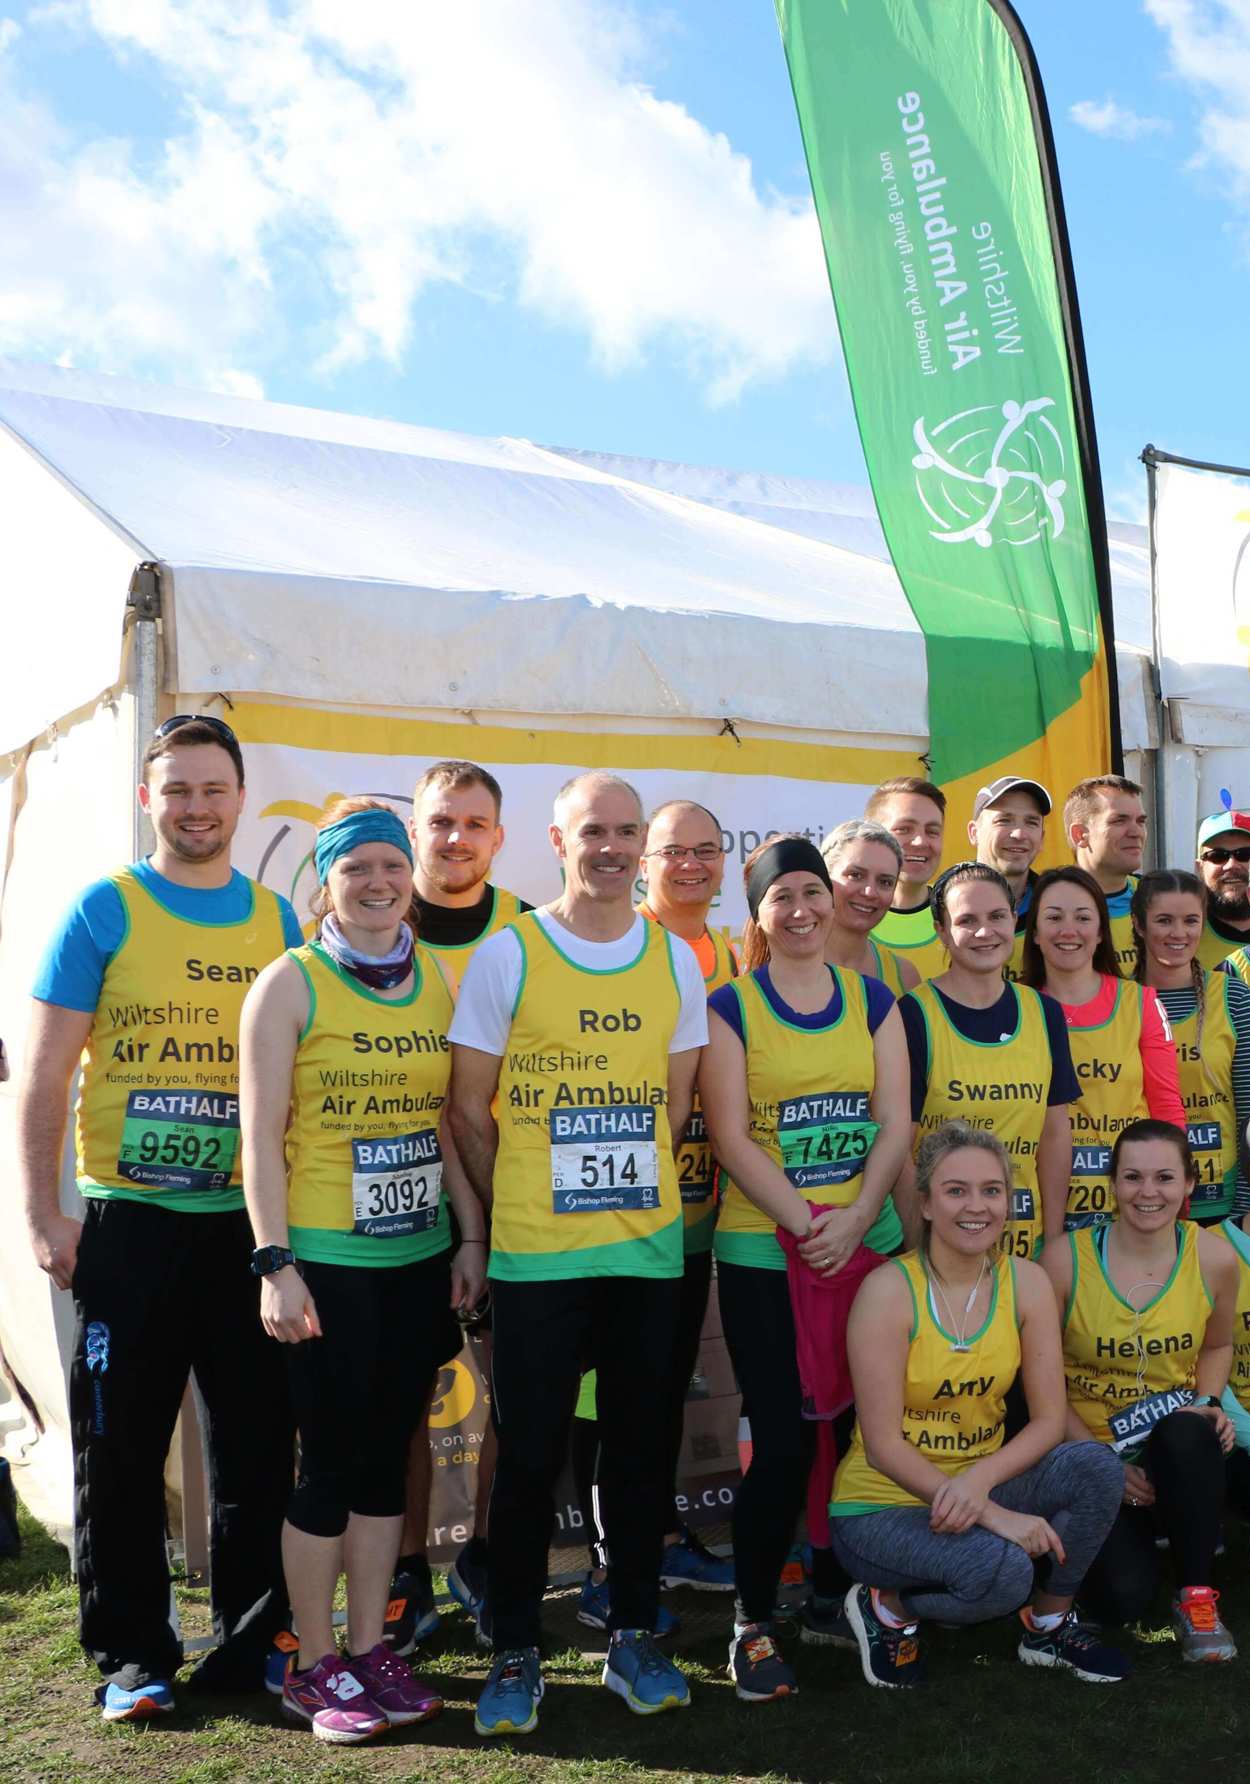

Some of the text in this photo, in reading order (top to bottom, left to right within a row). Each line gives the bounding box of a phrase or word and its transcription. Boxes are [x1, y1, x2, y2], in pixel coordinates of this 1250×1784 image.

[186, 959, 261, 983] Sean
[109, 1001, 220, 1028] Wiltshire
[579, 1008, 642, 1033] Rob
[112, 1037, 241, 1063] Air Amb
[353, 1029, 449, 1058] Sophie
[509, 1051, 608, 1072] Wiltshire
[106, 1072, 143, 1084] funded
[147, 1073, 161, 1086] by
[195, 1072, 227, 1086] flying
[319, 1070, 408, 1087] Wiltshire
[509, 1081, 668, 1108] Air Ambula
[948, 1079, 1043, 1103] Swanny
[133, 1096, 238, 1120] BATHALF
[321, 1092, 445, 1115] Air Ambula
[783, 1098, 867, 1122] BATHALF
[556, 1113, 653, 1136] BATHALF
[919, 1113, 994, 1130] Wilhire
[139, 1131, 221, 1169] 9592
[358, 1136, 438, 1165] BATHALF
[595, 1144, 623, 1152] Robert
[797, 1128, 867, 1164] 7425
[580, 1153, 639, 1188] 514
[368, 1176, 429, 1217] 3092
[1096, 1332, 1193, 1360] Helena
